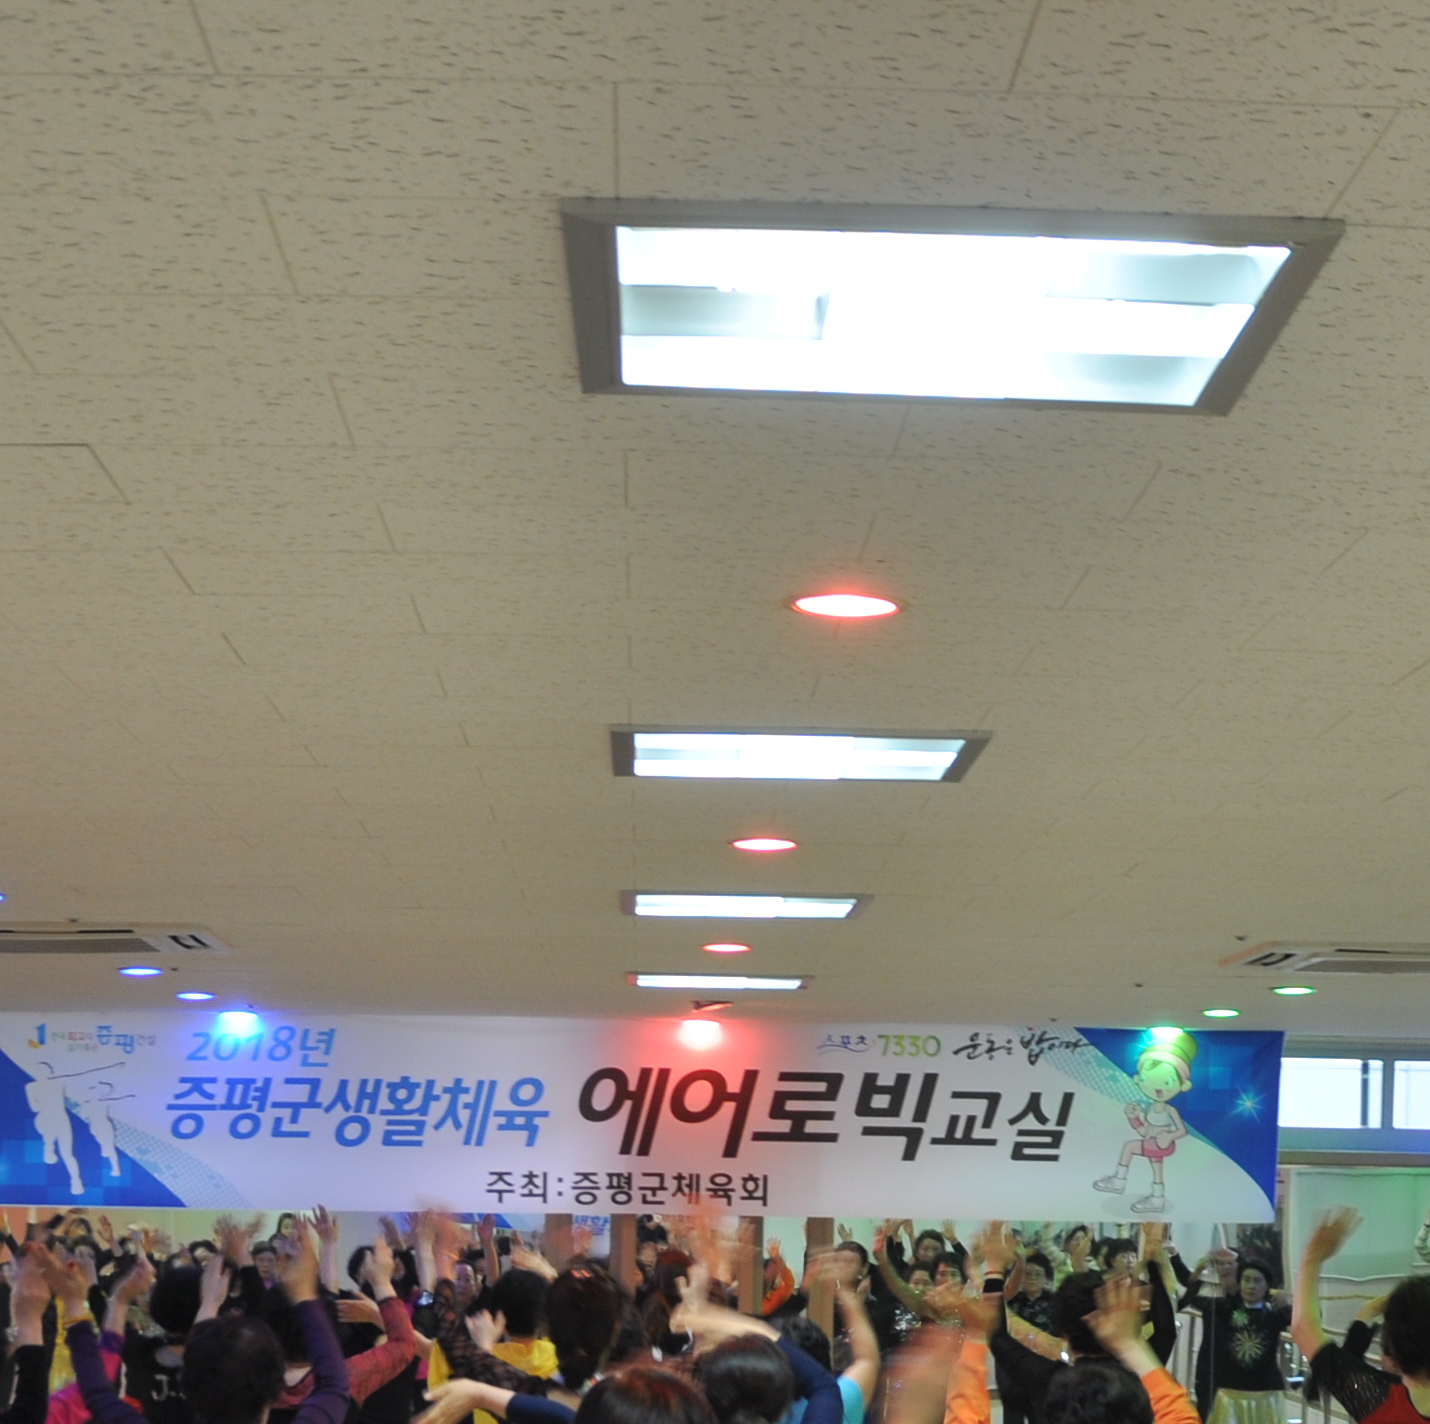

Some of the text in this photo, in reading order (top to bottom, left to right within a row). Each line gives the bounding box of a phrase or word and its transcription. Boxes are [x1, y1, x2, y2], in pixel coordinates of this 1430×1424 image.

[185, 1025, 336, 1067] 2018년
[877, 1034, 942, 1057] 7330
[166, 1076, 550, 1147] 증평군생활체육
[578, 1066, 1075, 1162] 에어로빅교실
